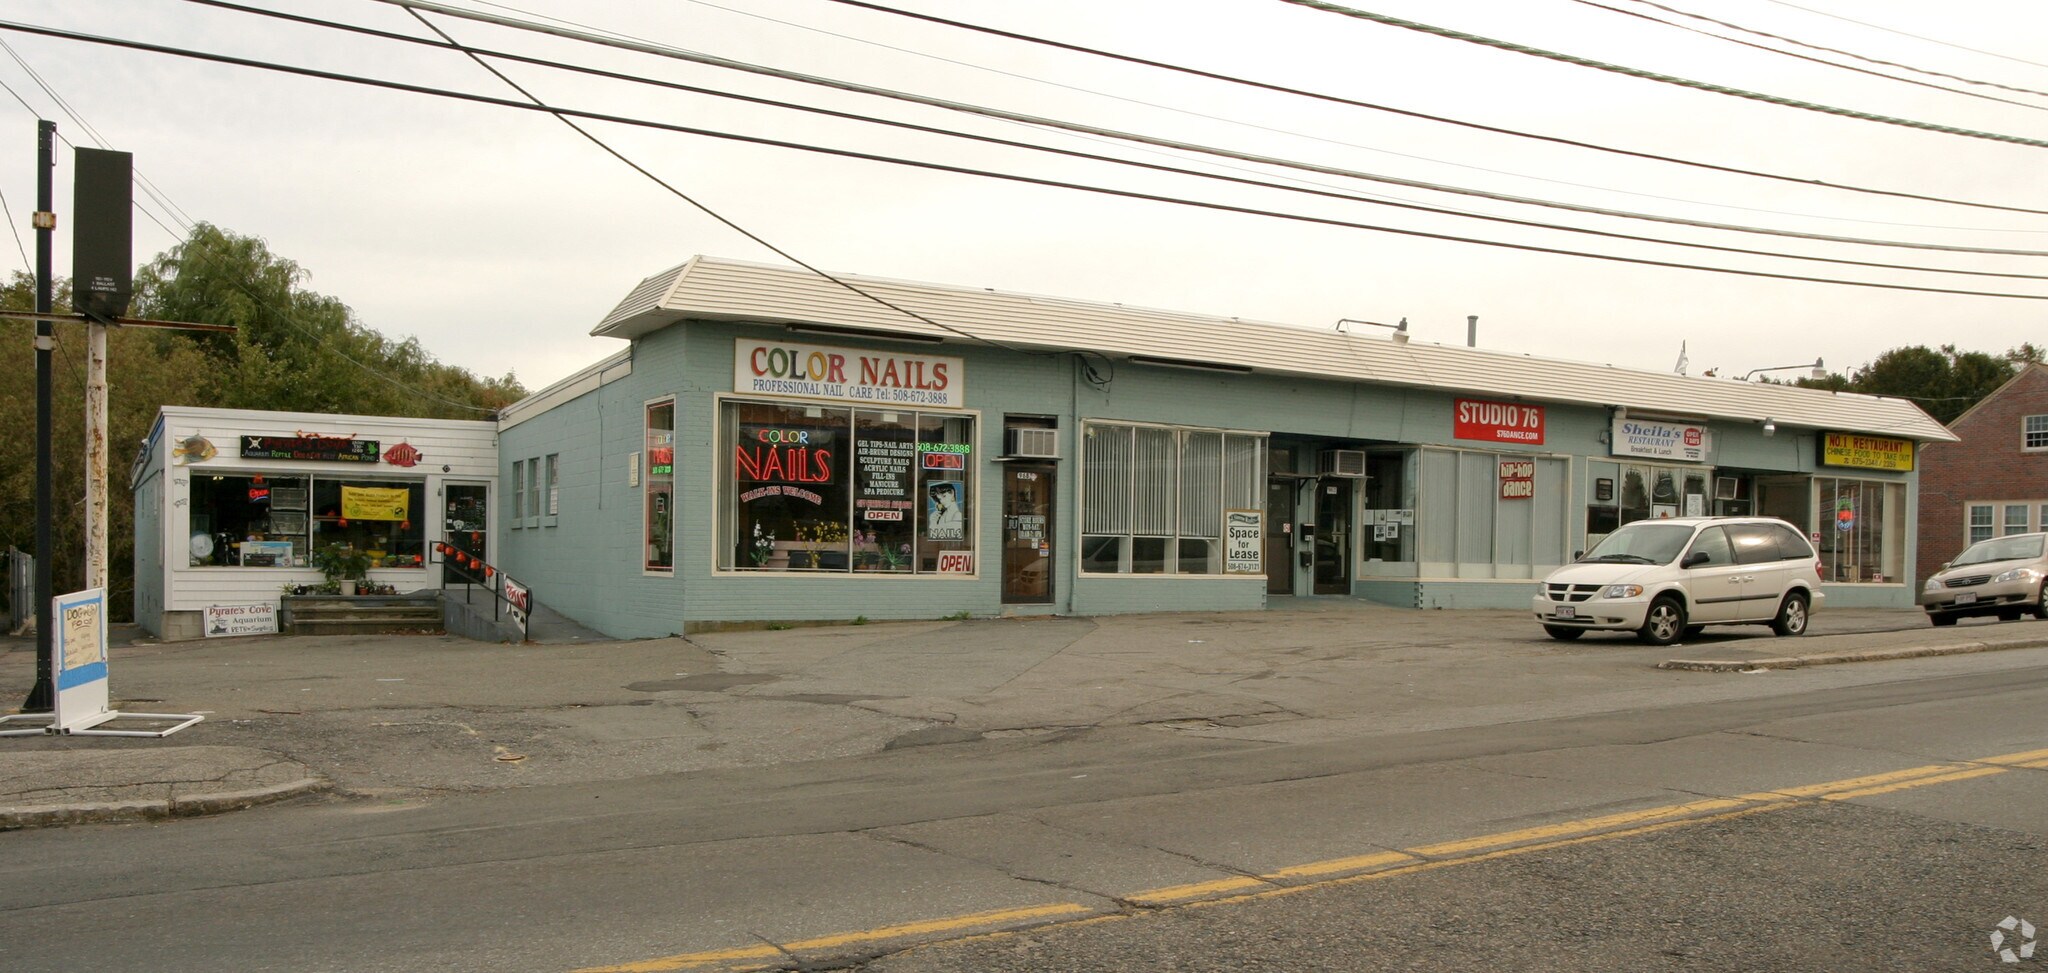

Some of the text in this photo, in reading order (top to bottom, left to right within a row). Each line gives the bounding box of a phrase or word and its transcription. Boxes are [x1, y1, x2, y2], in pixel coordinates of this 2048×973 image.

[750, 347, 949, 391] COLOR NAILS
[753, 378, 948, 404] PROFESSIONAL NAIL CARE Tel: 508-672-3888
[1460, 401, 1538, 428] STUDIO 76
[758, 429, 808, 444] COLOR
[1496, 430, 1538, 440] S76DANCE.COM
[1622, 423, 1681, 439] Sheila's
[857, 440, 914, 450] GEL TIPS-NAIL ARTS
[1628, 436, 1676, 447] RESTAURANT
[1853, 437, 1903, 452] RESTAURANT
[858, 448, 914, 457] AIR-BRUSH DESIGNS
[1827, 448, 1851, 456] CHINESE
[1855, 450, 1870, 458] FOOD
[1884, 452, 1896, 460] TAKE
[736, 444, 832, 482] NAILS
[859, 457, 910, 466] SCULPTURE NAILS
[926, 454, 962, 468] OPEN
[864, 465, 906, 473] ACRYLIC NAILS
[740, 486, 823, 506] WALK-INS WELCOME
[876, 488, 904, 496] PEDICURE
[868, 512, 900, 520] OPEN
[929, 528, 963, 540] NAILS
[1230, 527, 1259, 540] Space
[1238, 540, 1249, 548] for
[1230, 548, 1259, 559] Lease
[940, 554, 972, 572] OPEN
[209, 606, 272, 618] Pyrate's Cove
[233, 616, 272, 624] Aquarium
